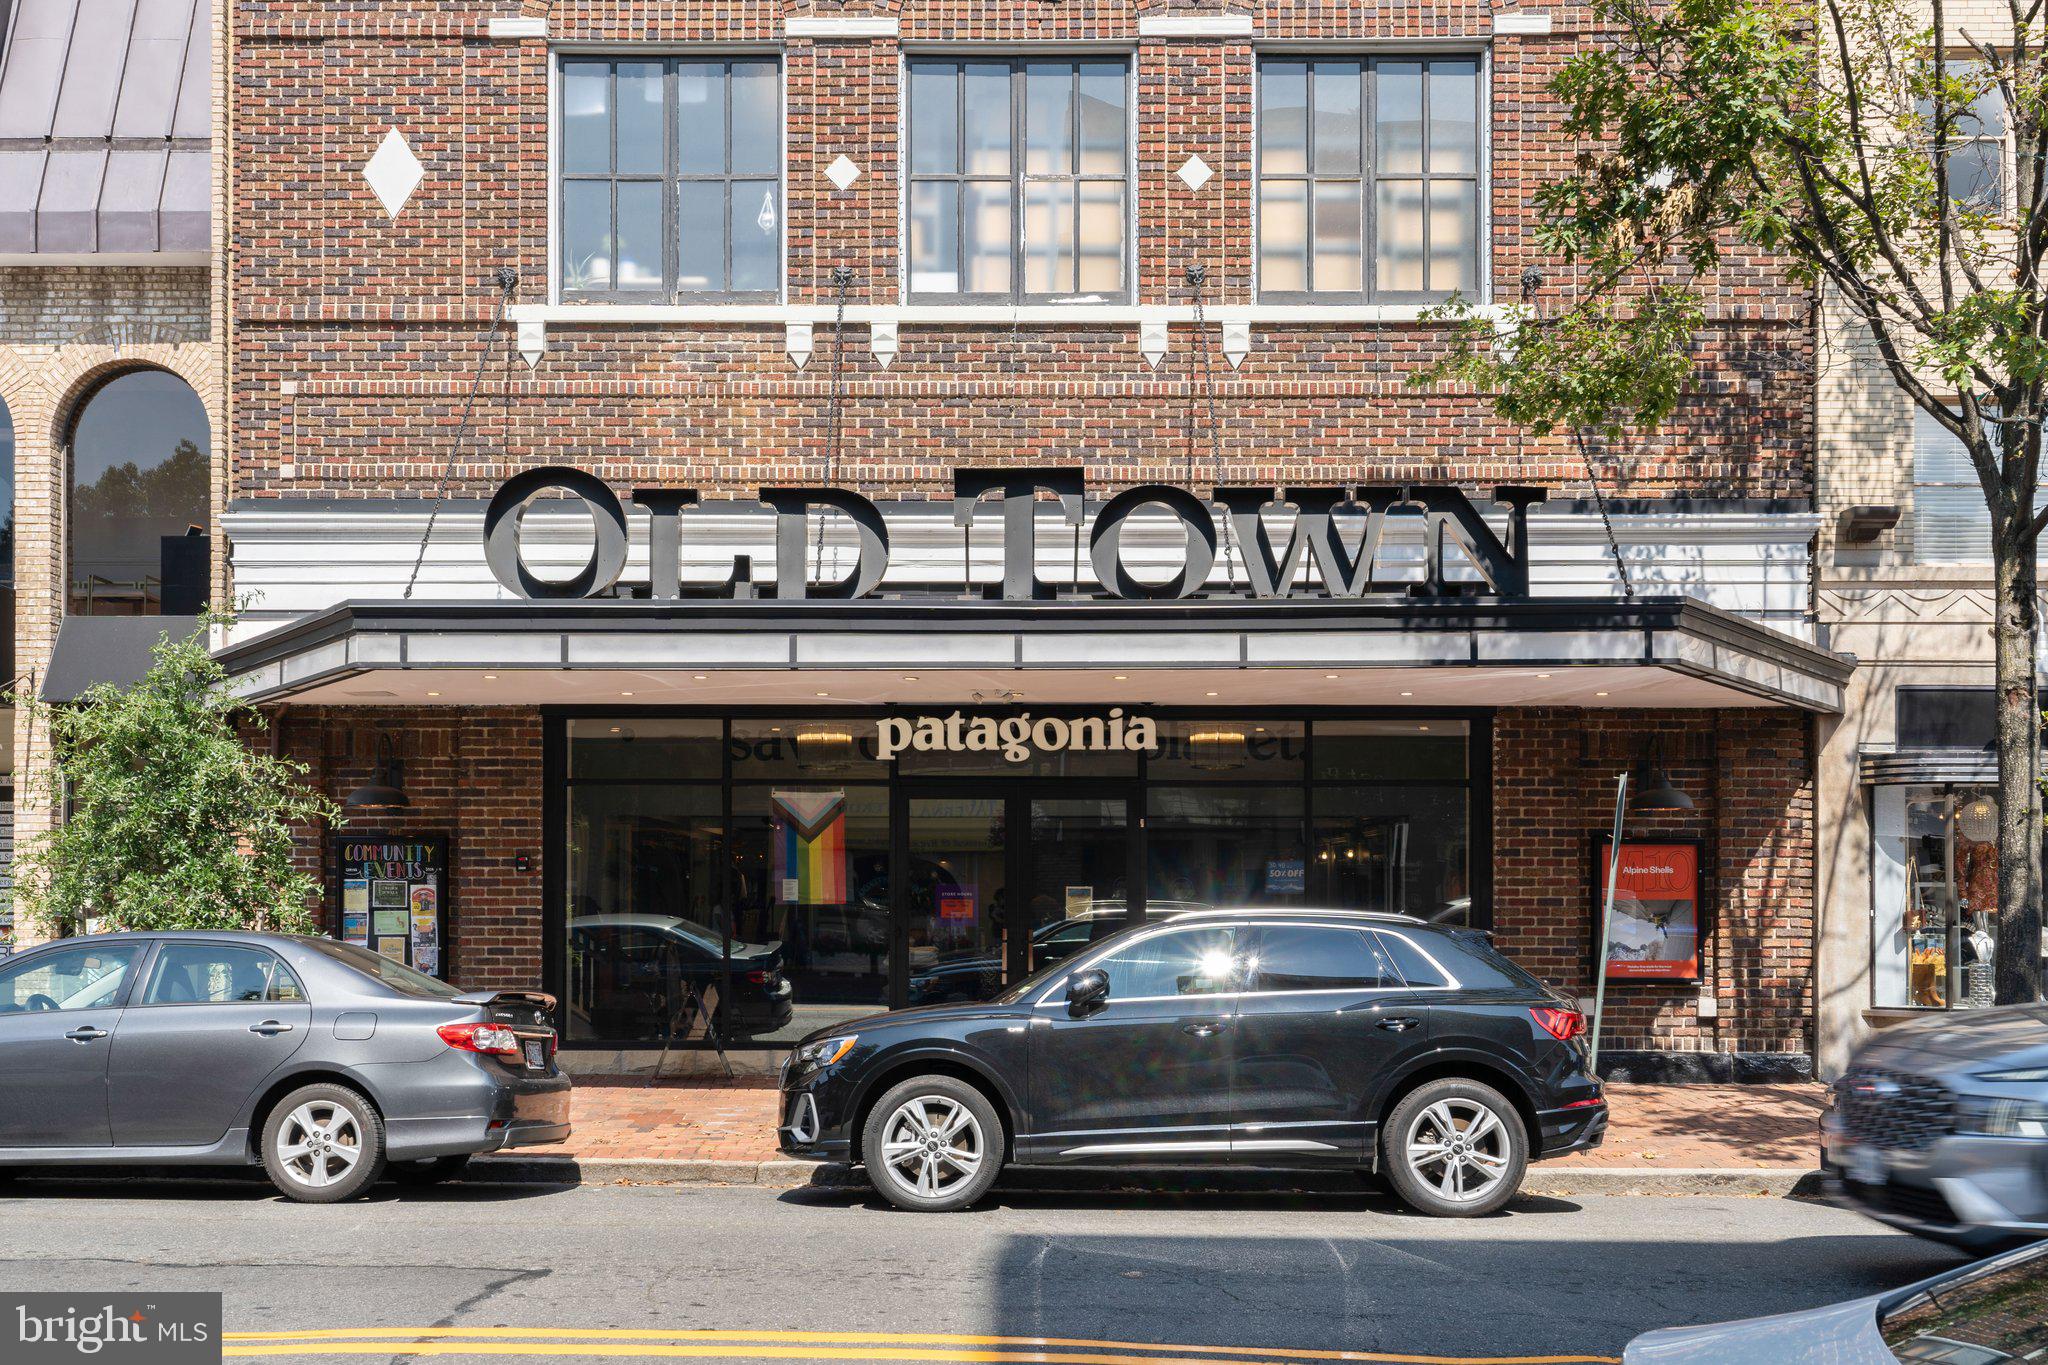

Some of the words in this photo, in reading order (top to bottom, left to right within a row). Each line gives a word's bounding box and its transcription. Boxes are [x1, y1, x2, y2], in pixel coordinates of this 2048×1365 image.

[483, 466, 890, 600] OLD
[953, 467, 1547, 600] TOWN
[875, 707, 1159, 762] patagonia
[344, 844, 434, 862] COMMUNITY
[363, 862, 422, 879] EVENTS
[1622, 866, 1648, 875] Alpine
[1649, 866, 1674, 874] Shells
